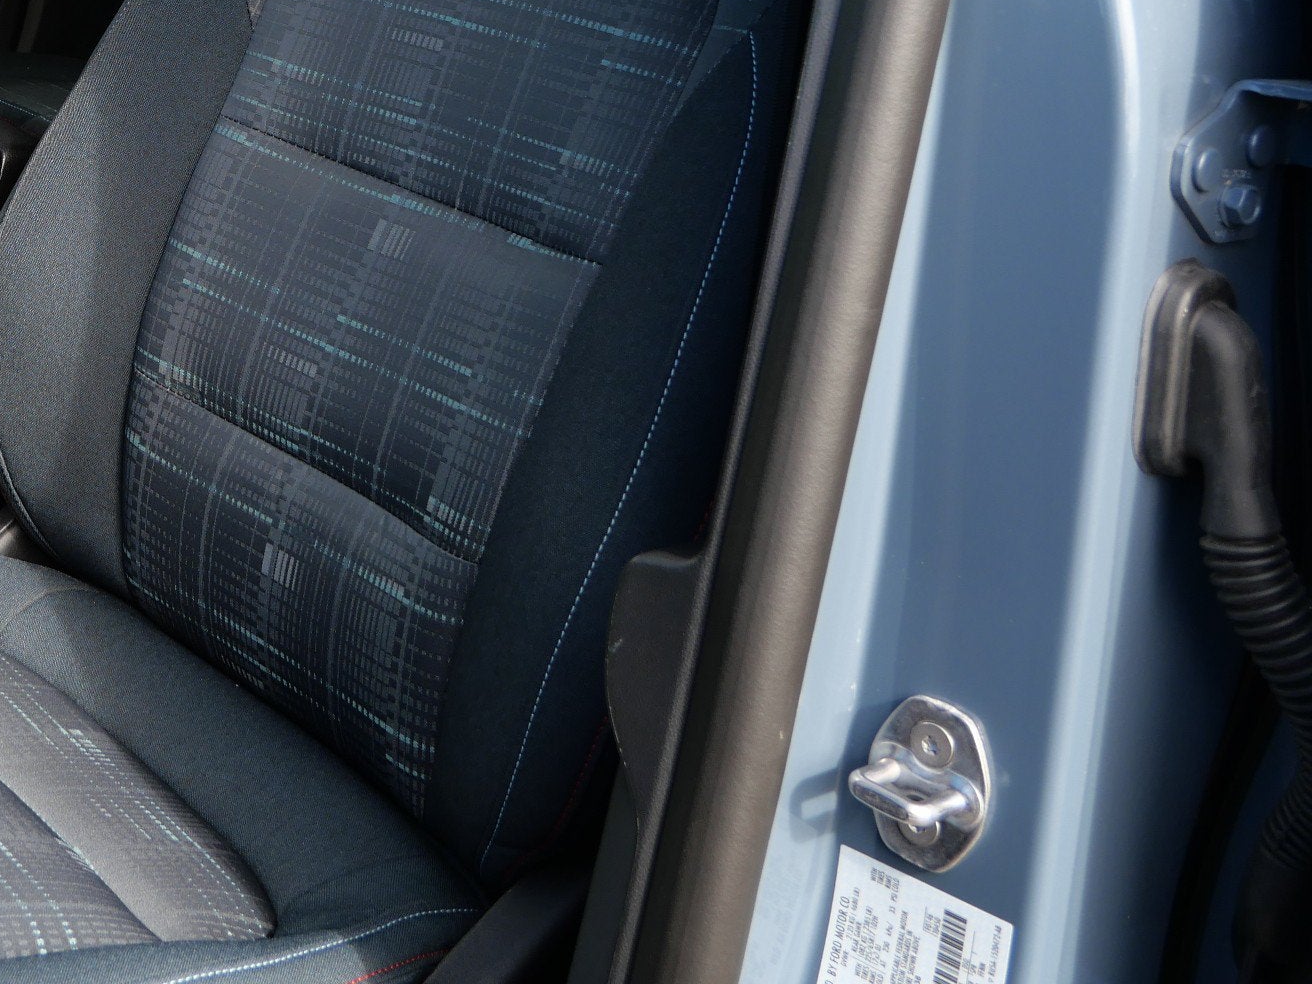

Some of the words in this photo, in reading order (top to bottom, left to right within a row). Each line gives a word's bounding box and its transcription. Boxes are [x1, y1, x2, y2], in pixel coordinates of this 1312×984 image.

[840, 896, 850, 909] CO
[834, 909, 848, 940] MOTOR
[854, 922, 862, 938] GAWR
[899, 911, 908, 931] MOTOR
[829, 940, 842, 964] FORD
[851, 939, 859, 953] REAR
[895, 931, 905, 955] FEDERAL
[911, 936, 920, 955] ABOVE
[827, 963, 838, 977] BY
[907, 955, 917, 975] SHOWN
